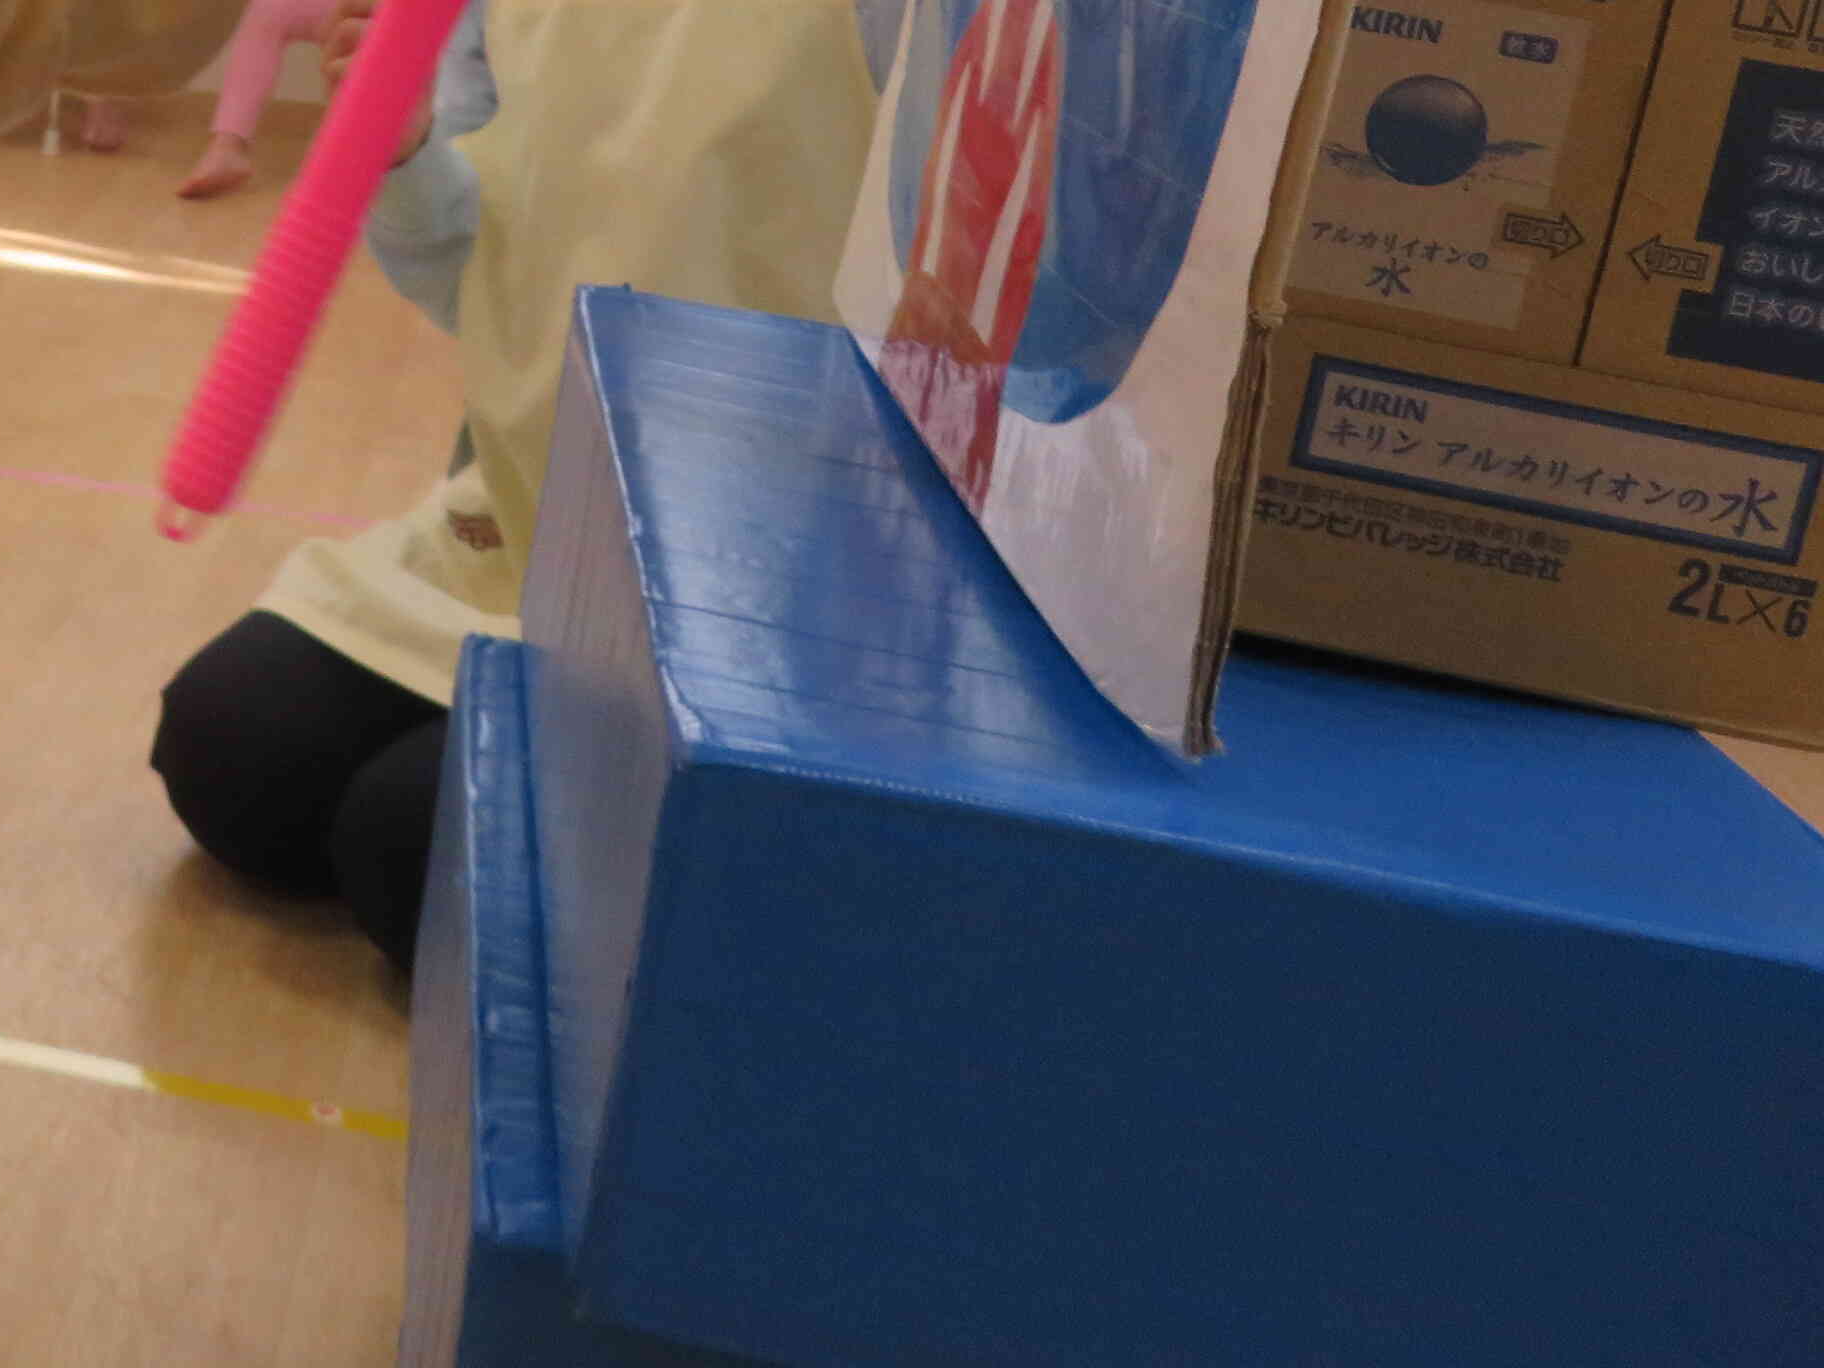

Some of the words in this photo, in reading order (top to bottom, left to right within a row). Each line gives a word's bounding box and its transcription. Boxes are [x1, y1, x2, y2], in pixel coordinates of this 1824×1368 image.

[1350, 5, 1444, 44] KIRIN
[1311, 221, 1490, 269] アルカリイオンの
[1366, 257, 1413, 297] 水
[1727, 291, 1824, 331] 日本の
[1333, 383, 1429, 423] KIRIN
[1327, 418, 1422, 456] キリン
[1436, 438, 1782, 537] アルカリイオンの水
[1253, 498, 1565, 583] キリンビバレッジ株式会社
